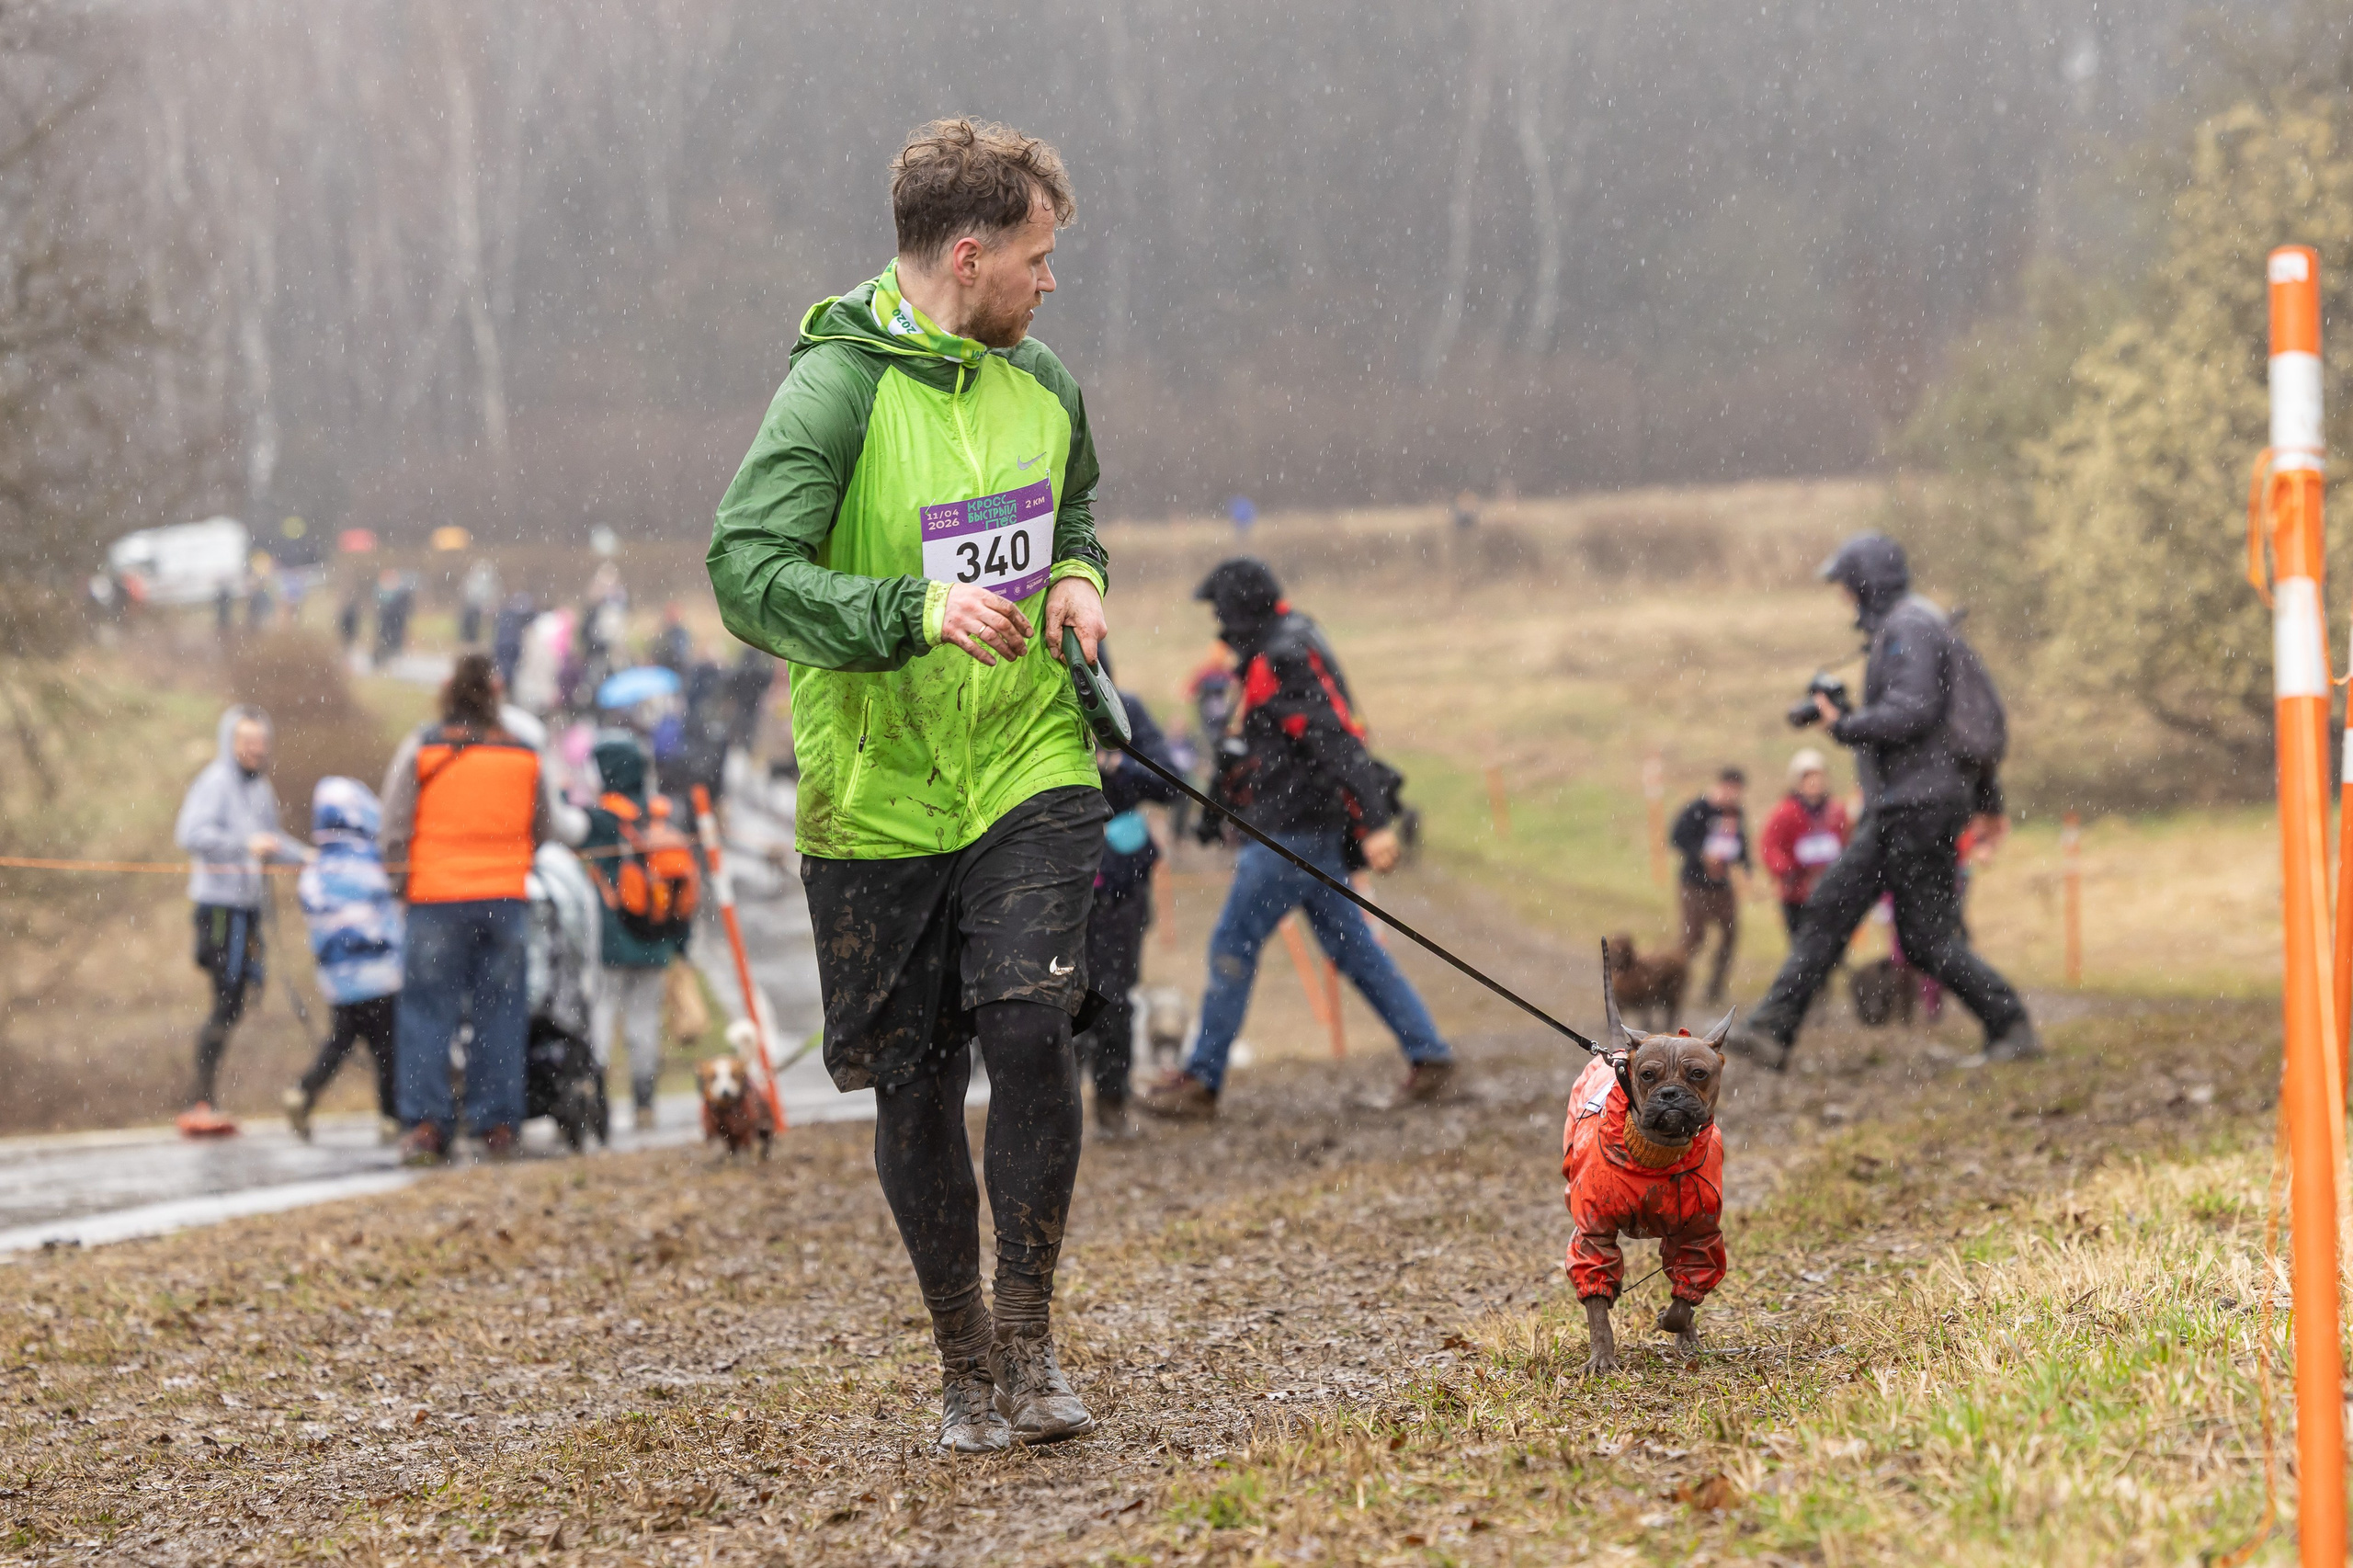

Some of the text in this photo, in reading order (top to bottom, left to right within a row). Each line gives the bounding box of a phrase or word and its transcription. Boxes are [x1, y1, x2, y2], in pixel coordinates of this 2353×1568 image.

[892, 308, 916, 335] 2020
[967, 494, 1006, 513] КРОСС
[1025, 499, 1031, 508] 2
[926, 509, 960, 520] 11/04
[928, 518, 960, 530] 2026
[956, 529, 1029, 583] 340
